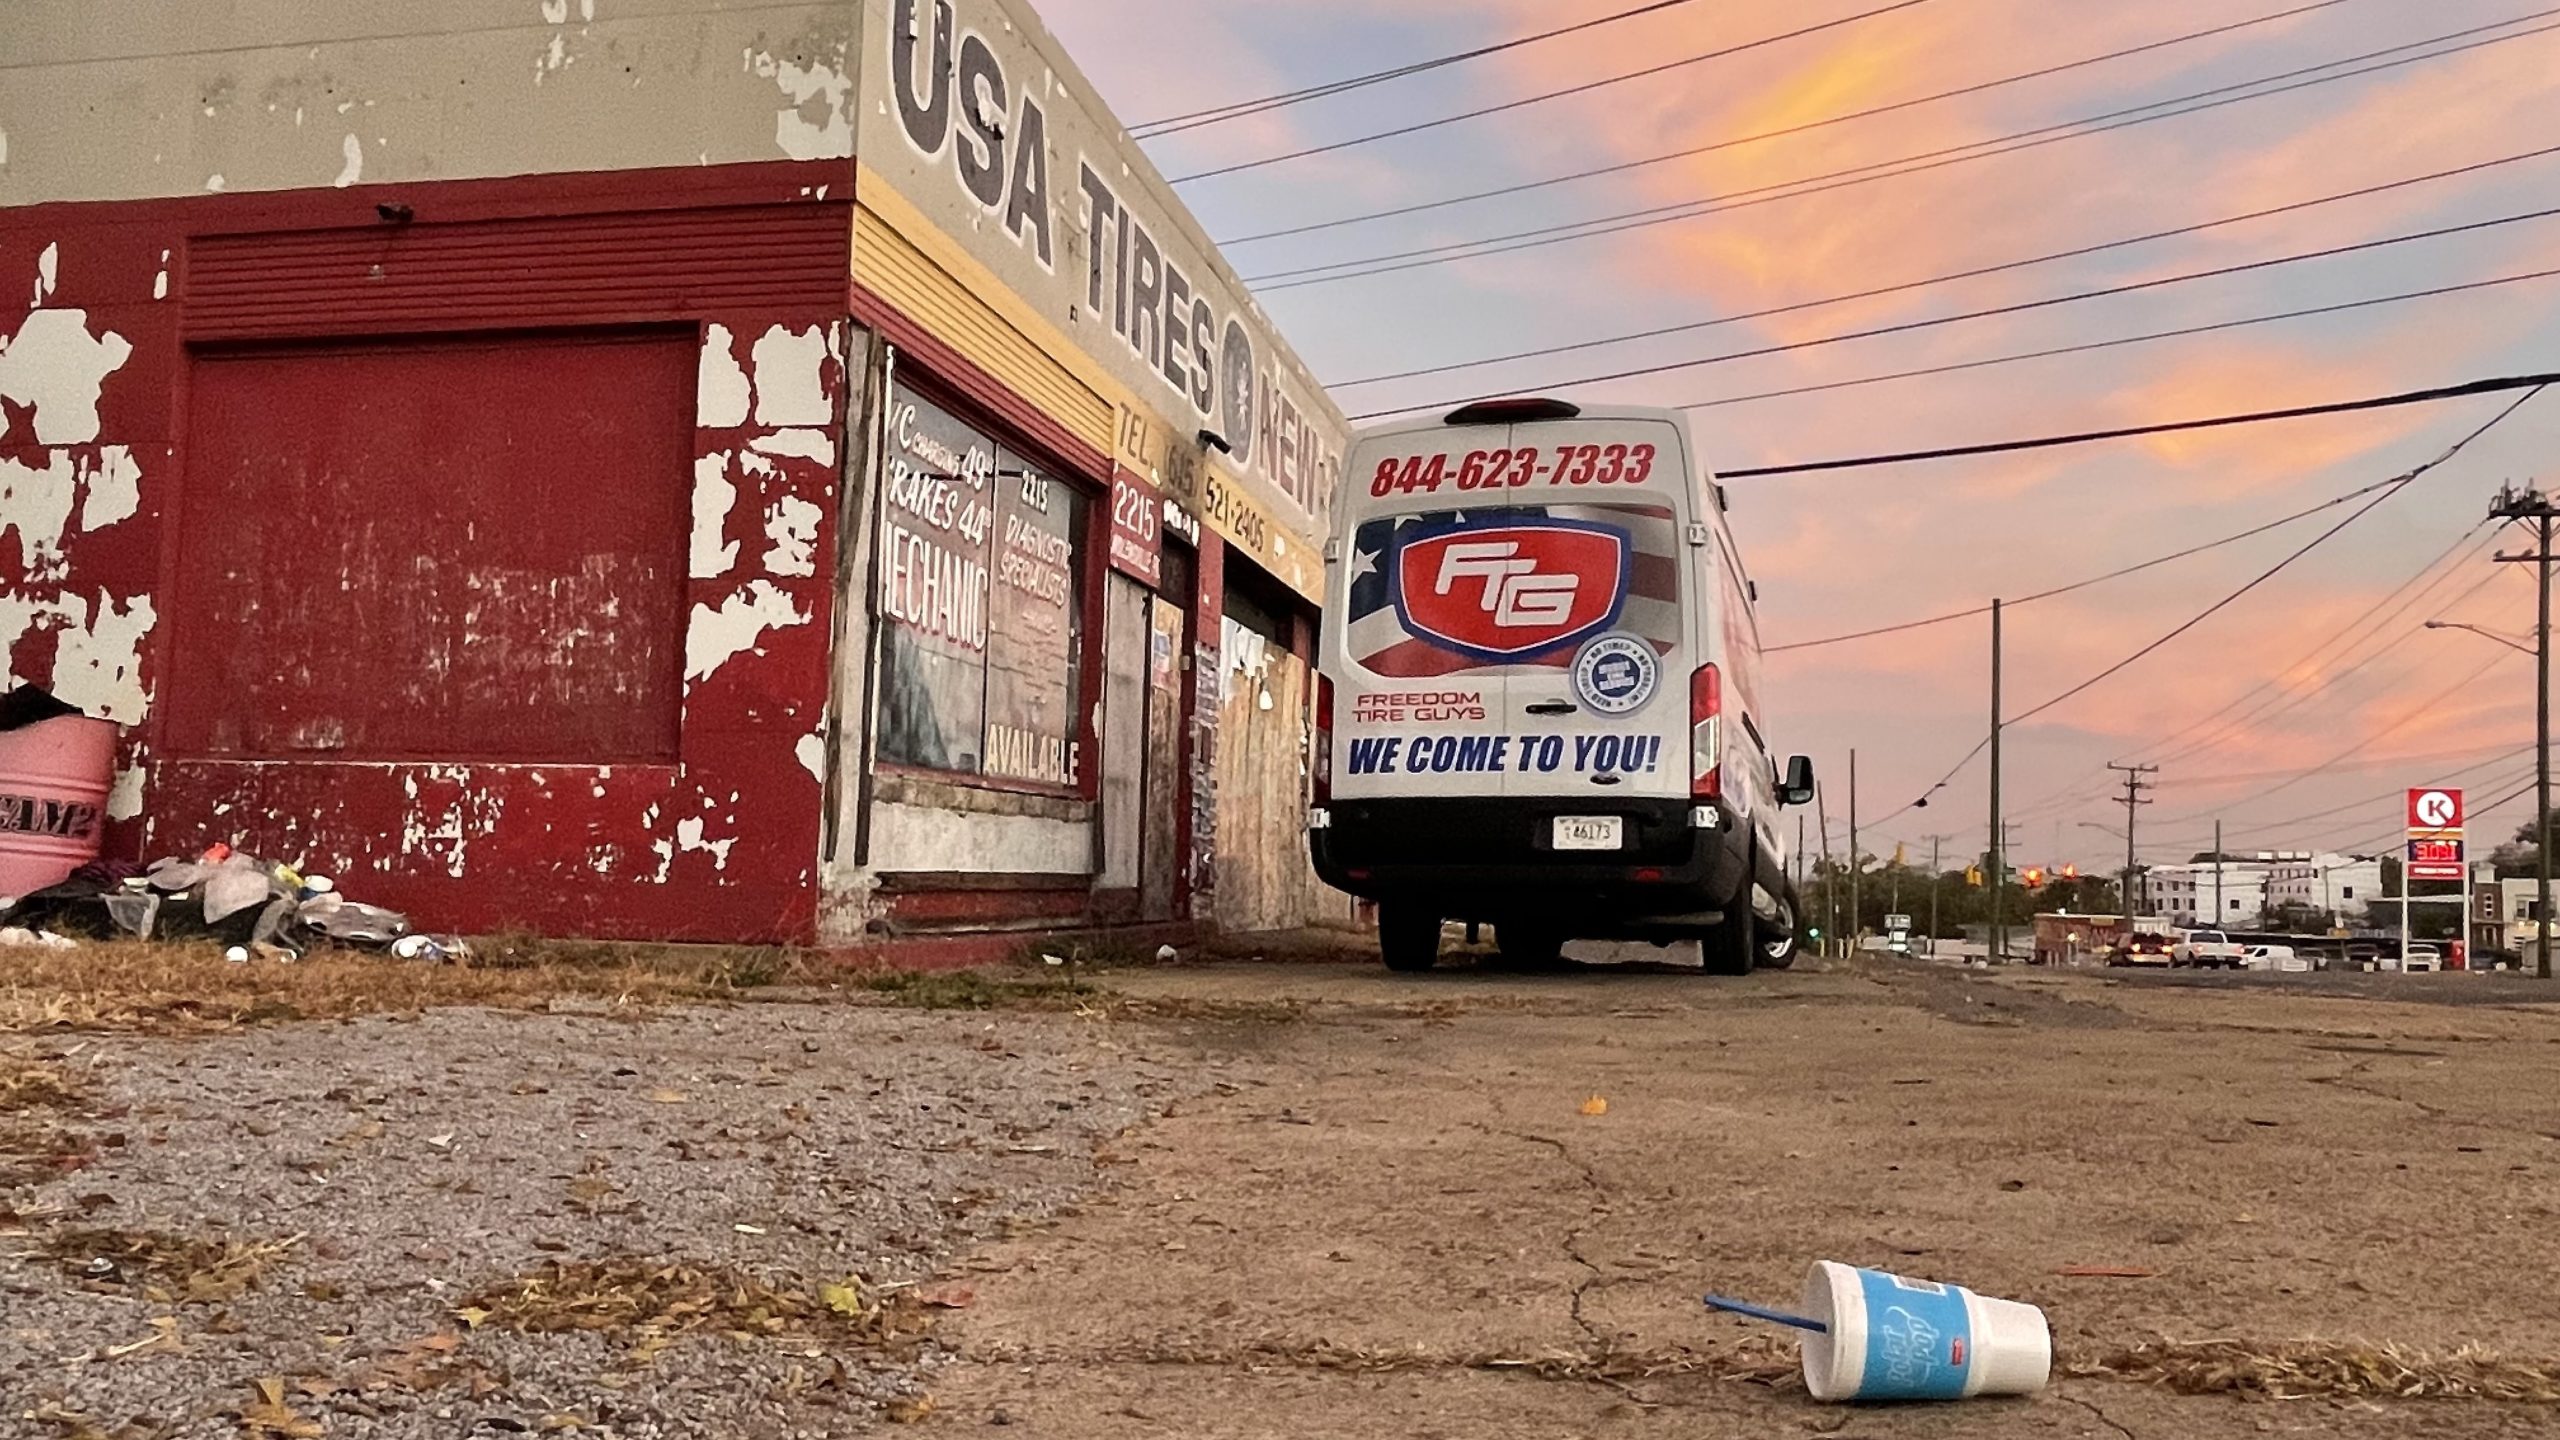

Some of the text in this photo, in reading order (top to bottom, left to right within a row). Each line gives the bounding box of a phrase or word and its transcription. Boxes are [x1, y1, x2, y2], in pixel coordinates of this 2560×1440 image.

[891, 0, 1318, 517] USA TIRES NEW
[889, 457, 958, 530] RAKES
[1021, 469, 1048, 512] 2215
[1370, 444, 1656, 498] 844-623-7333
[1113, 480, 1155, 543] 2215
[1434, 541, 1579, 627] FTG
[1352, 706, 1486, 723] TIRE GUYS
[1357, 692, 1481, 707] FREEDOM
[984, 724, 1079, 786] AVAILABLE
[1348, 735, 1661, 775] WE COME TO YOU!
[2427, 799, 2448, 822] K
